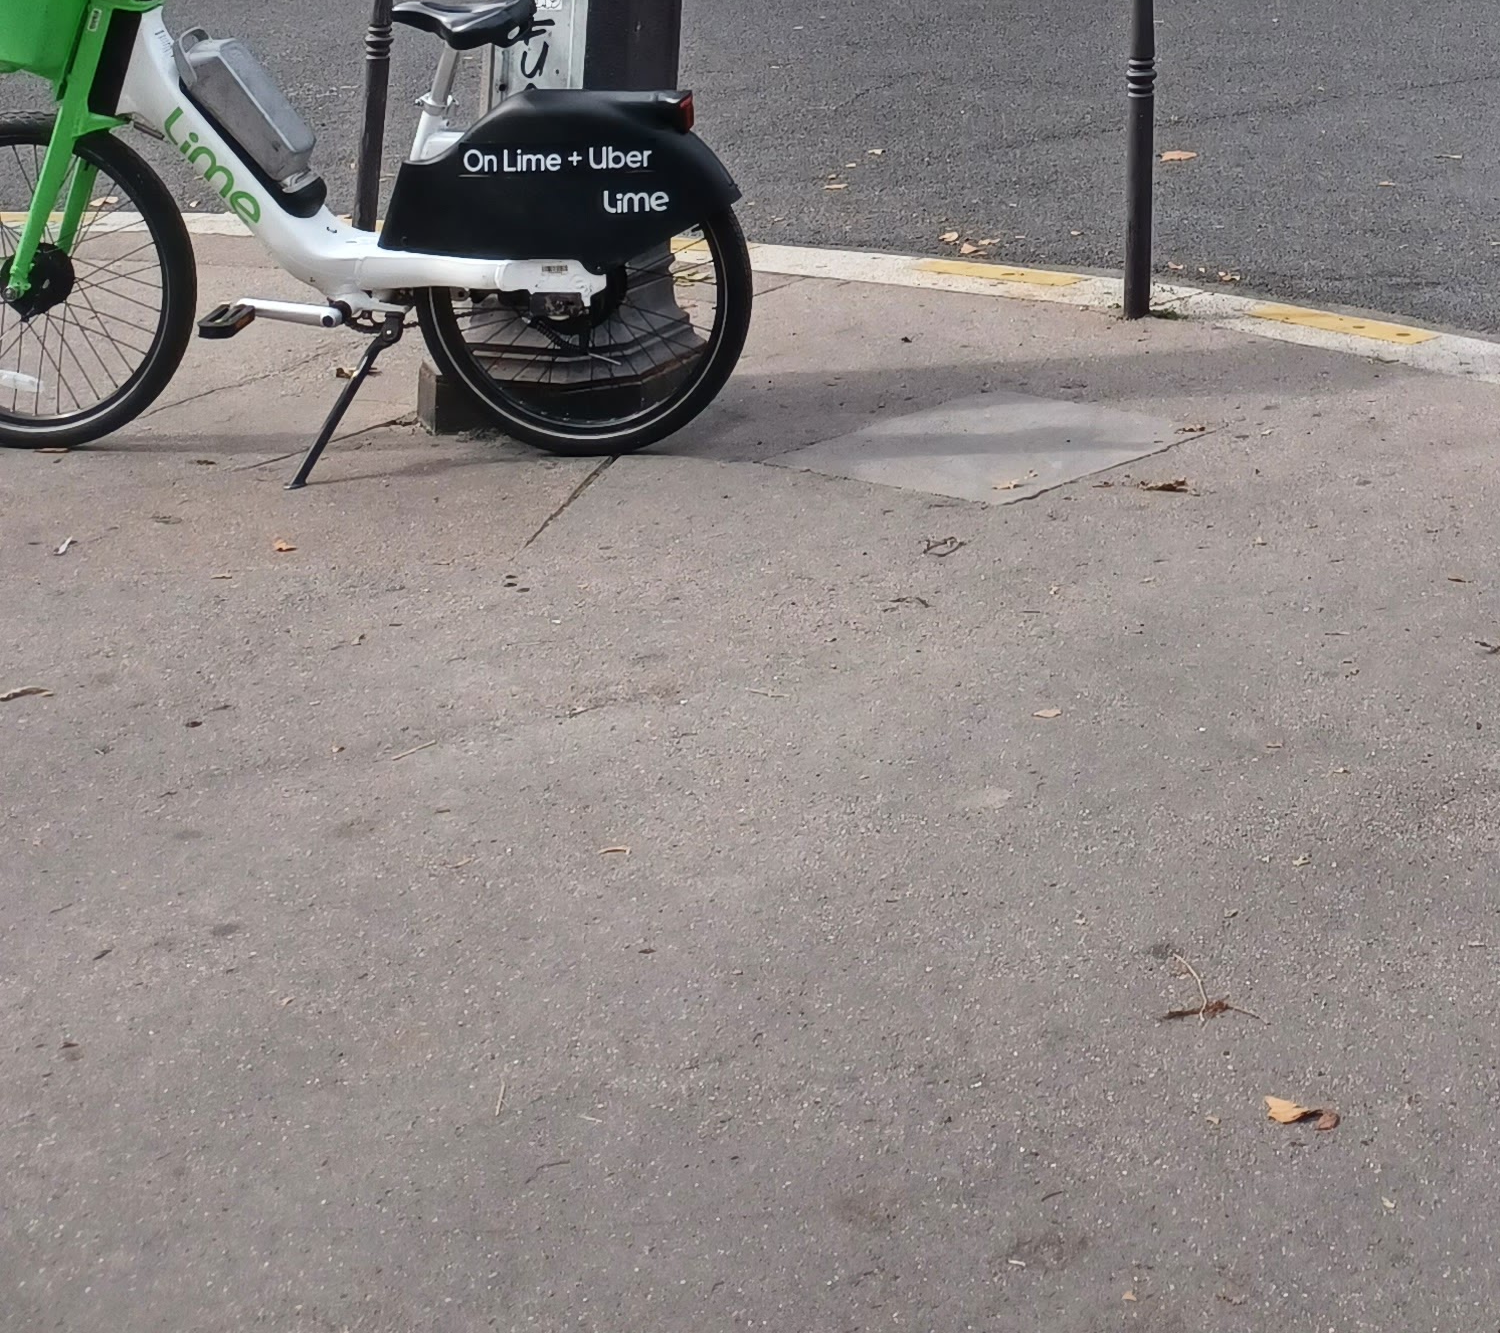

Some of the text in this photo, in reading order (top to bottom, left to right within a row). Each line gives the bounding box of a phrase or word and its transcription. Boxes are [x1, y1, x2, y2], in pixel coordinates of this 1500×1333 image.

[164, 106, 261, 224] Lime
[463, 149, 497, 172] On
[503, 149, 561, 172] Lime
[588, 146, 652, 170] Uber
[603, 190, 669, 214] Lime
